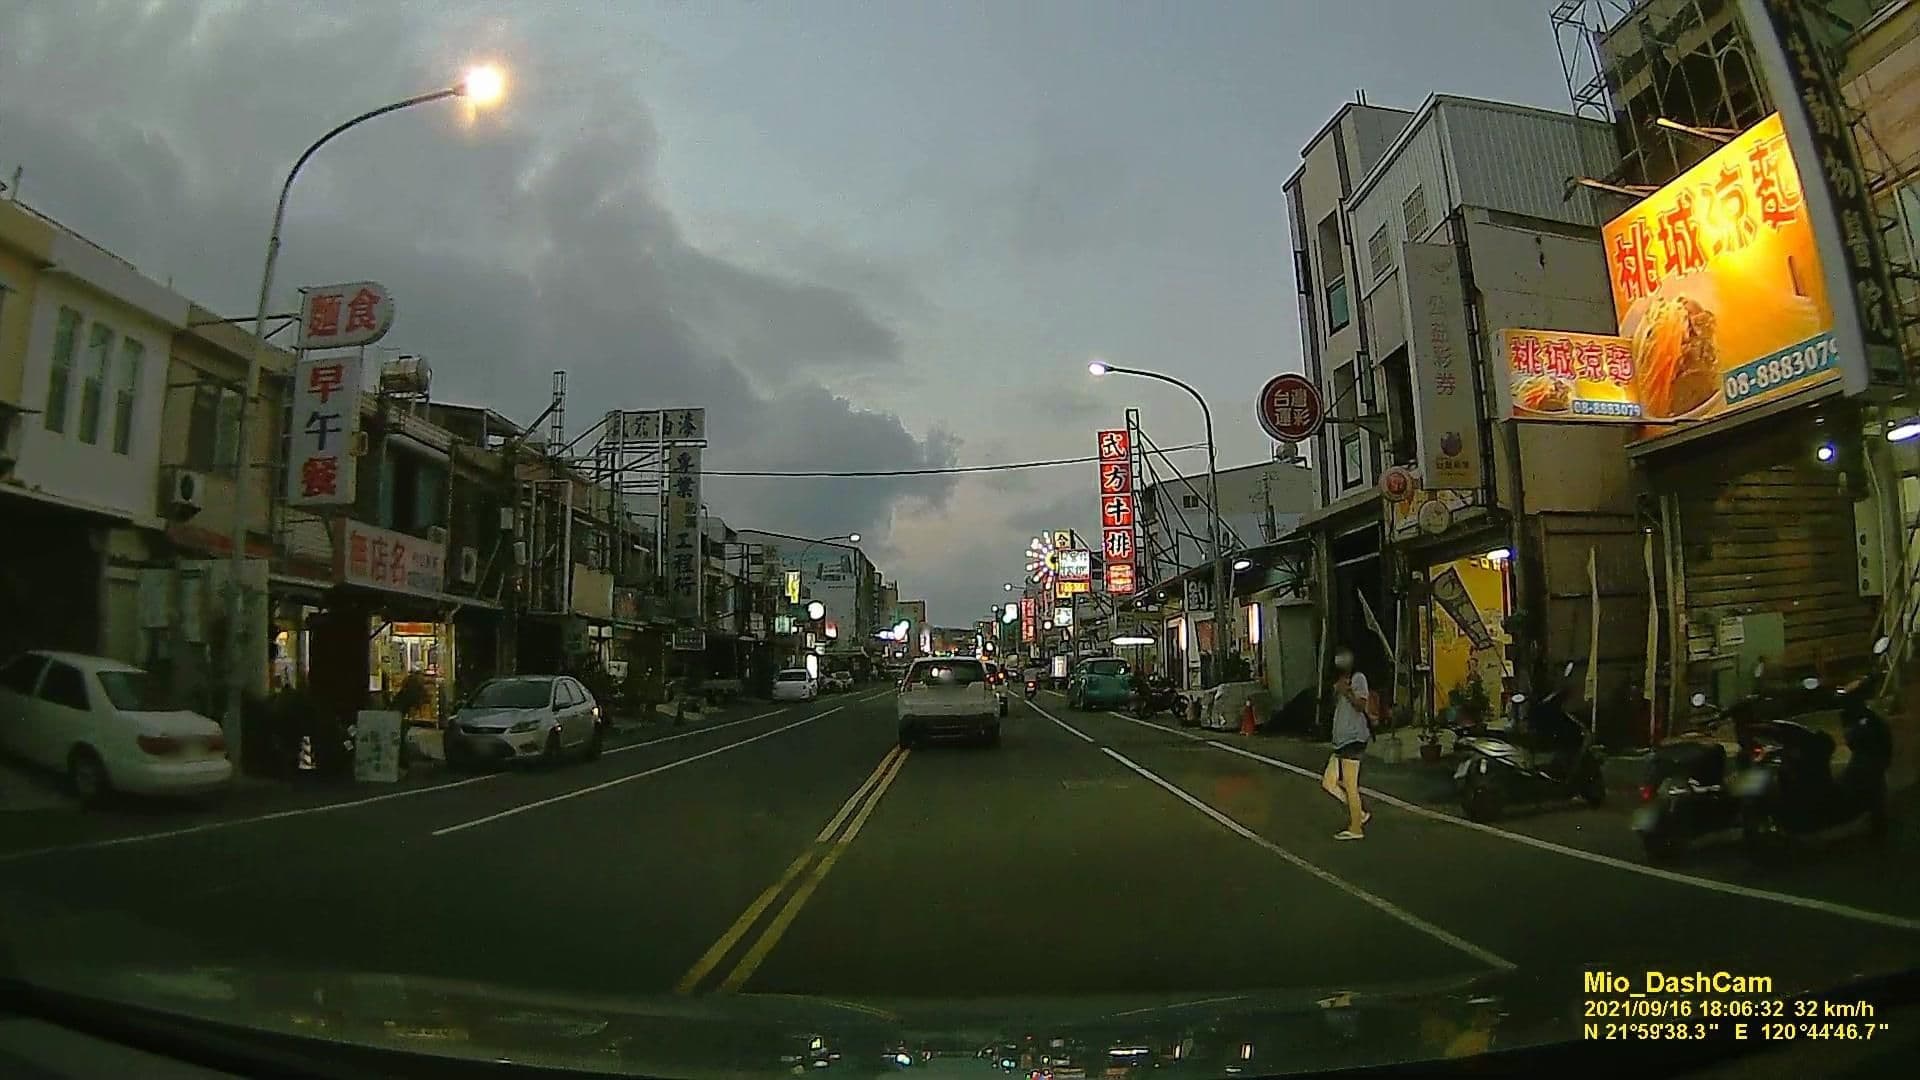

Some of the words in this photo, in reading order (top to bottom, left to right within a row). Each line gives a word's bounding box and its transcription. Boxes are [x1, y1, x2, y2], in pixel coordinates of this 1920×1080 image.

[302, 364, 344, 497] 早午餐
[1274, 389, 1307, 407] 台灣
